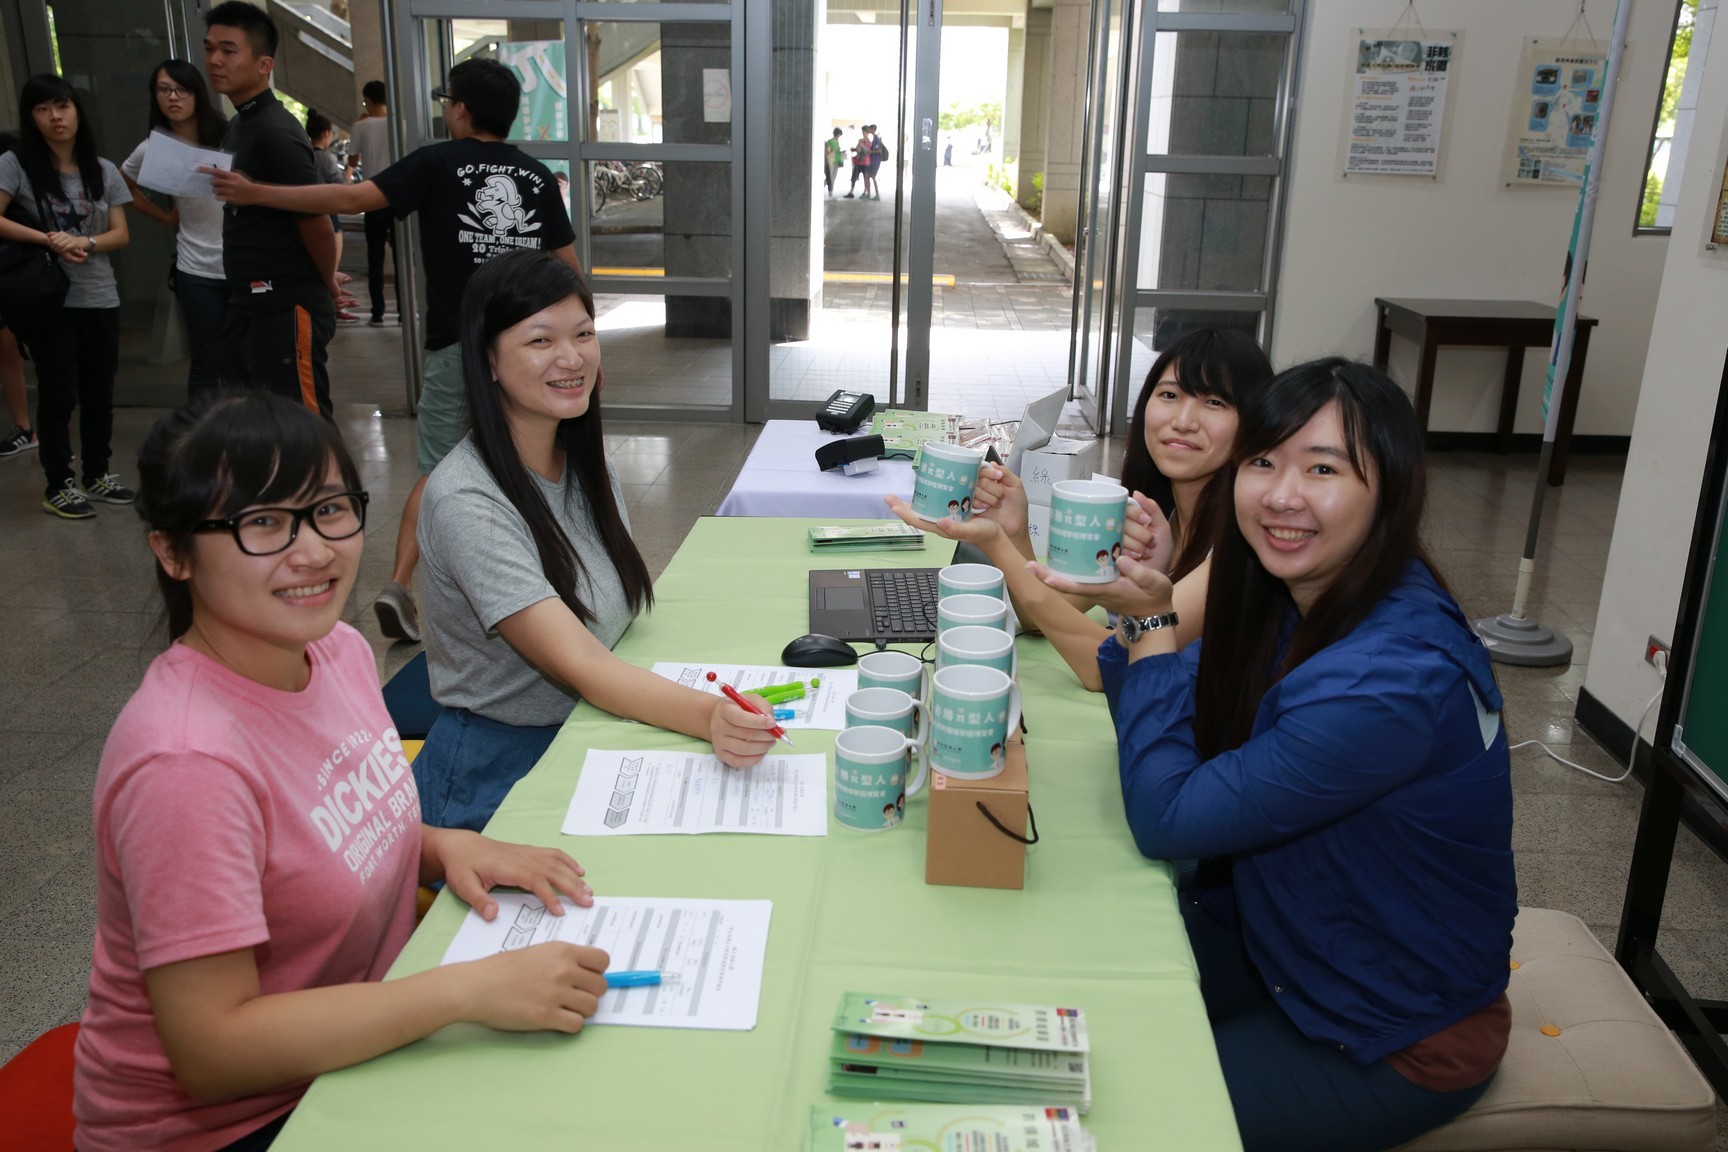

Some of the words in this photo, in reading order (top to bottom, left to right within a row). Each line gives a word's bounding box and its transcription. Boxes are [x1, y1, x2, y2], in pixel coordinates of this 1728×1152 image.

[458, 230, 474, 243] ONE
[500, 236, 514, 246] ONE
[472, 244, 486, 253] 20
[317, 742, 351, 788] SINCE
[310, 727, 409, 853] DICKIES
[343, 810, 392, 872] ORIGINAL
[359, 855, 378, 885] FORT
